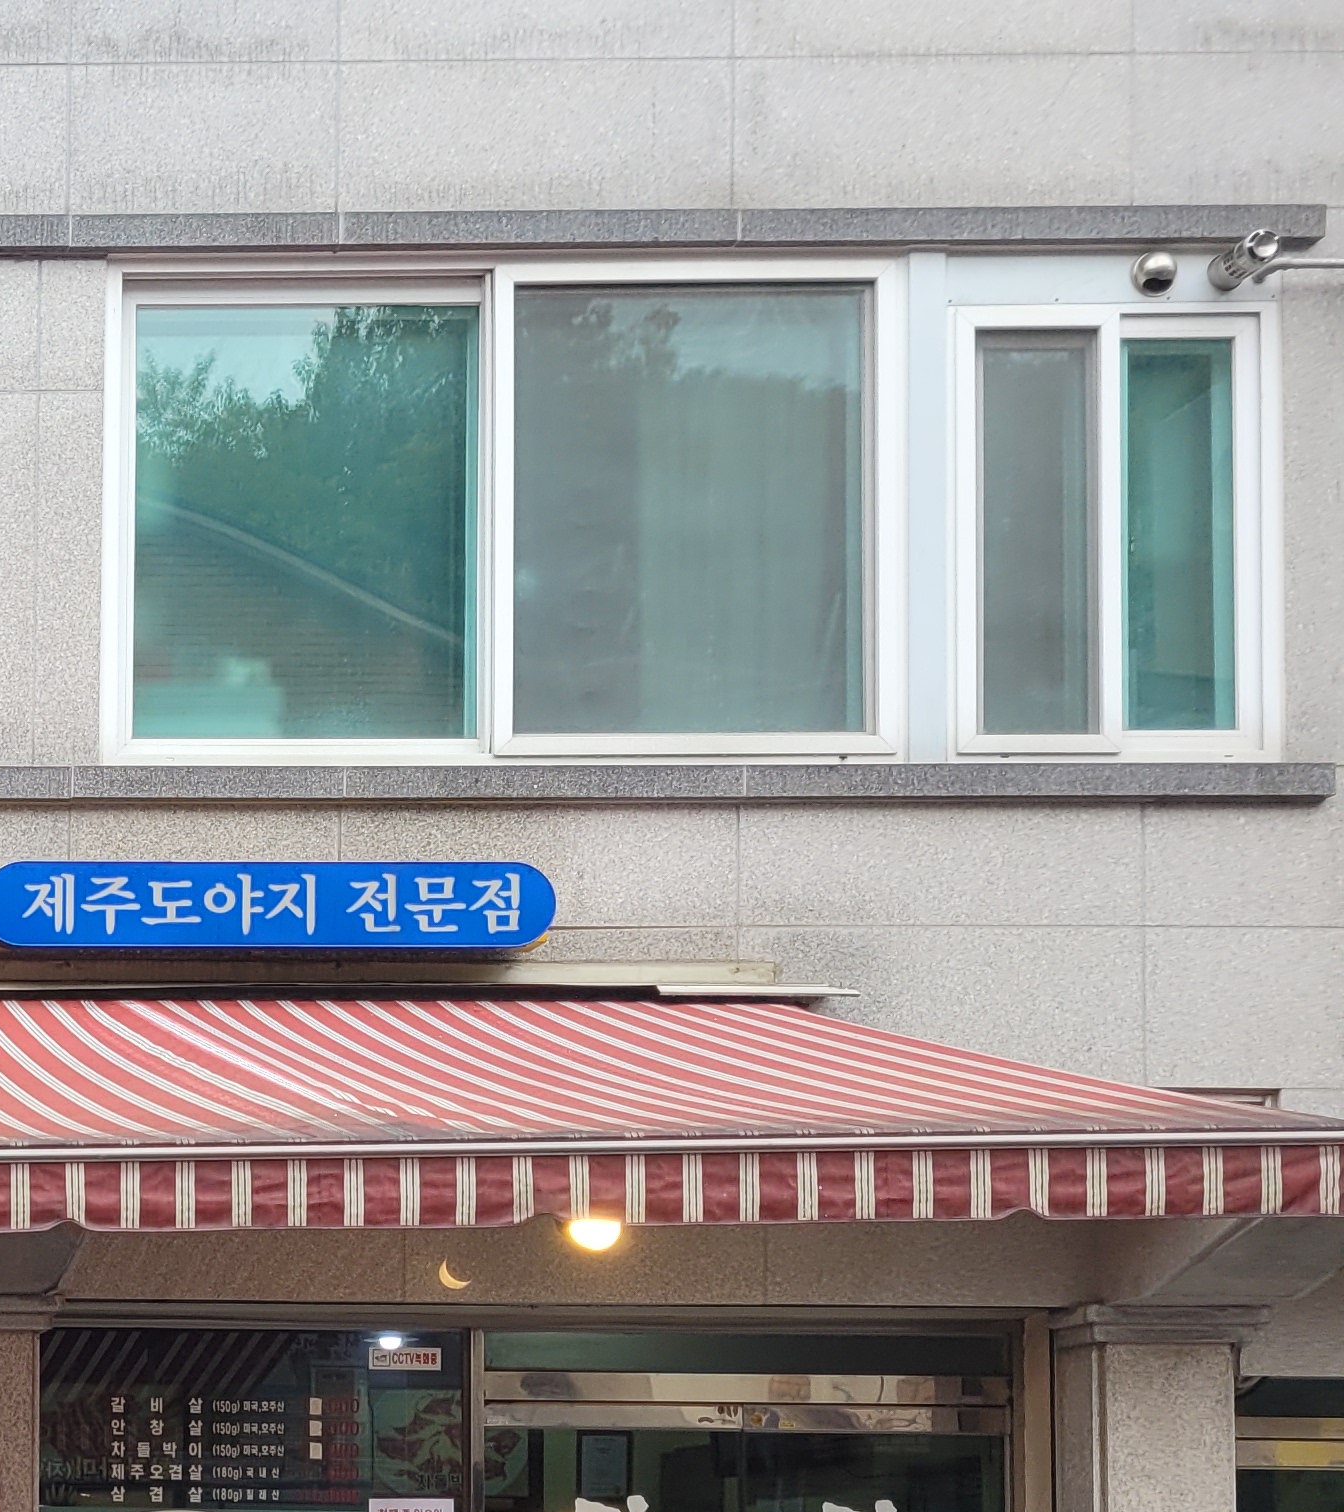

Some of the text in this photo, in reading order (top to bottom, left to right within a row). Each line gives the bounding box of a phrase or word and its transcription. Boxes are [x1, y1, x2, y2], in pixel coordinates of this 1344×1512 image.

[22, 872, 522, 934] 제주도야지 전문점
[212, 1400, 240, 1415] (150g)
[212, 1422, 240, 1437] (150g)
[212, 1444, 240, 1459] (150g)
[212, 1466, 243, 1482] (180g)
[212, 1488, 243, 1504] (180g)
